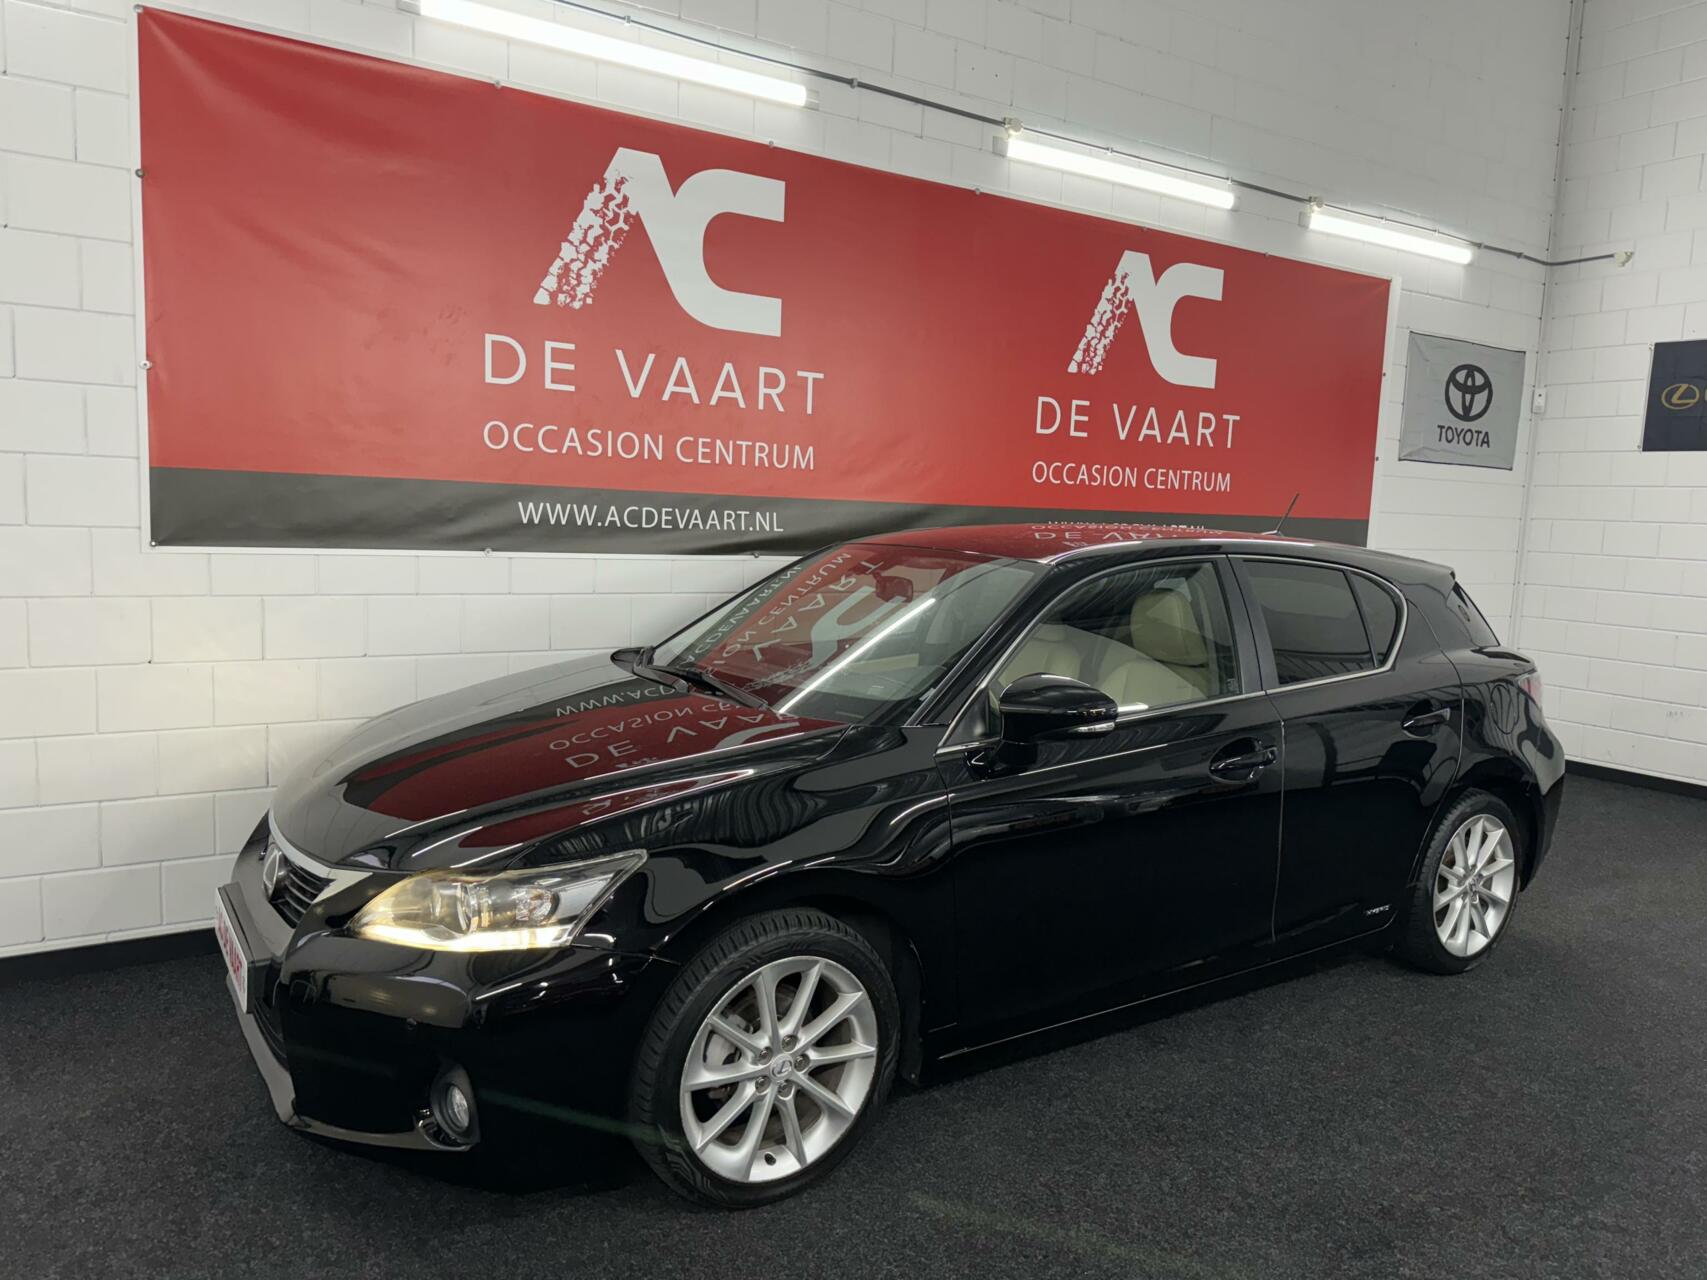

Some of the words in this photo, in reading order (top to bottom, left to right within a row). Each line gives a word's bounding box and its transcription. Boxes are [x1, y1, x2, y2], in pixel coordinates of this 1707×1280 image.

[533, 146, 787, 337] AC
[1068, 249, 1225, 390] AC
[484, 333, 576, 392] DE
[615, 349, 825, 415] VAART
[483, 420, 663, 461] OCCASION
[675, 436, 815, 470] CENTRUM
[1035, 396, 1090, 438] DE
[1112, 403, 1241, 449] VAART
[1433, 420, 1490, 448] TOYOTA
[1032, 460, 1138, 488] OCCASION
[1143, 467, 1231, 492] CENTRUM
[517, 501, 784, 532] WWW.ACDEVAART.NL
